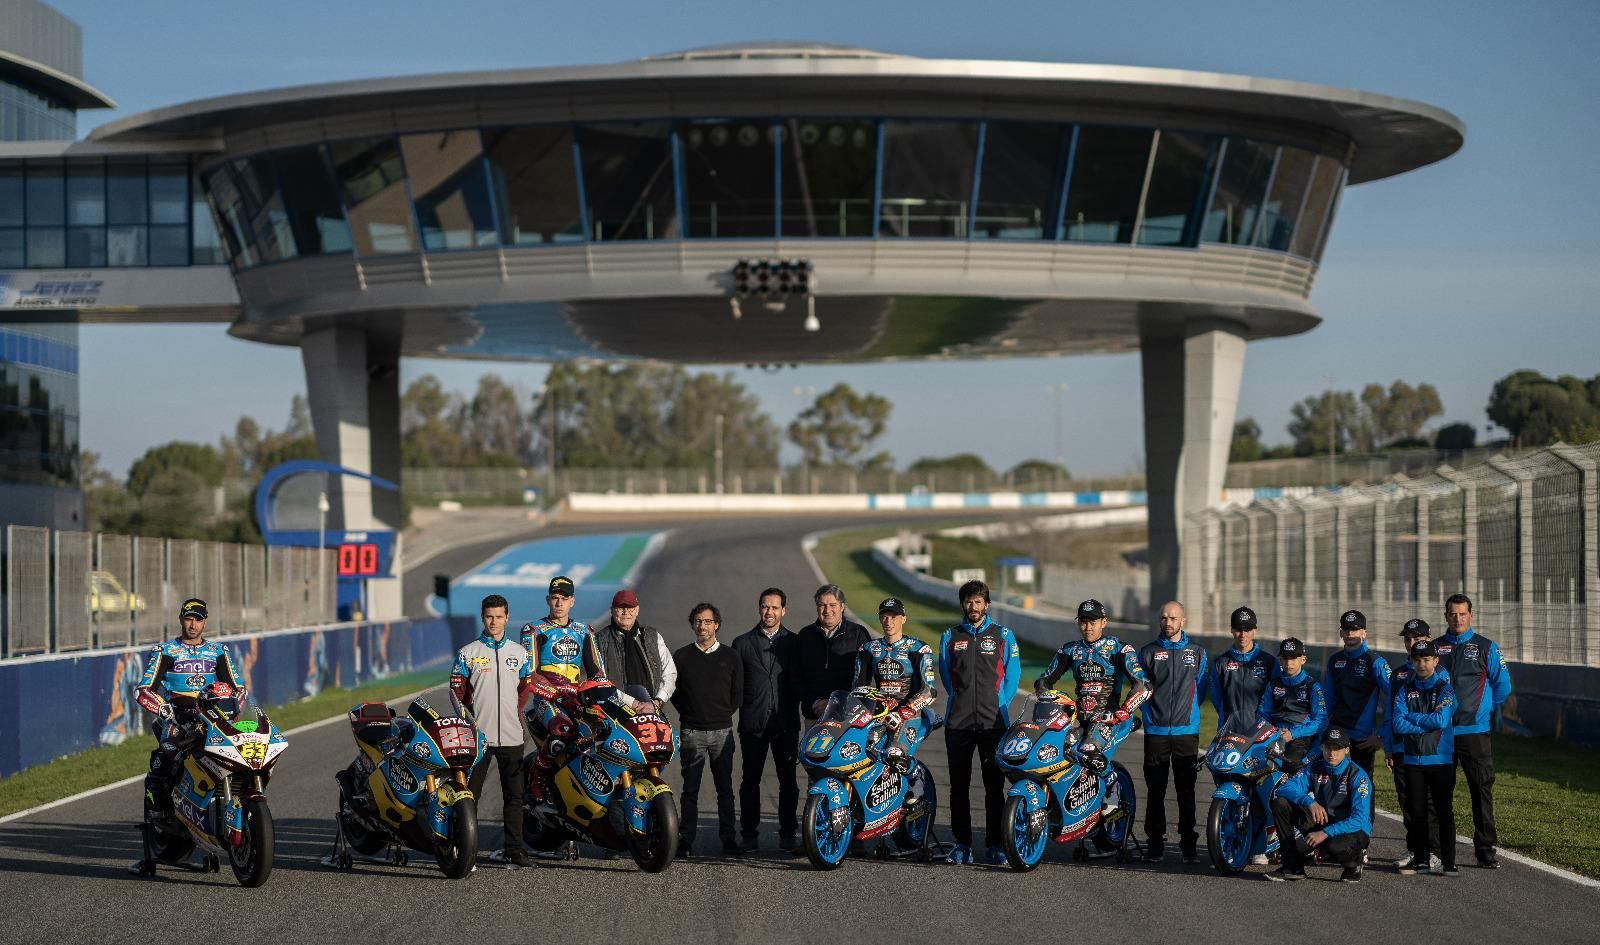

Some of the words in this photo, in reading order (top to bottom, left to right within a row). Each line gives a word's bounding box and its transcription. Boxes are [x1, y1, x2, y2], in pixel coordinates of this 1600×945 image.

[19, 281, 104, 295] JEREZ
[339, 544, 377, 575] 00
[174, 661, 206, 672] enel
[433, 717, 470, 727] TOTAL
[629, 714, 666, 724] TOTAL
[438, 727, 476, 749] 22
[638, 722, 672, 743] 37
[582, 766, 604, 792] Galicia
[584, 758, 609, 786] Estrella
[871, 772, 899, 797] Estrella
[1069, 774, 1096, 799] Estrella
[872, 785, 899, 807] Galicia
[1070, 787, 1096, 809] Galicia
